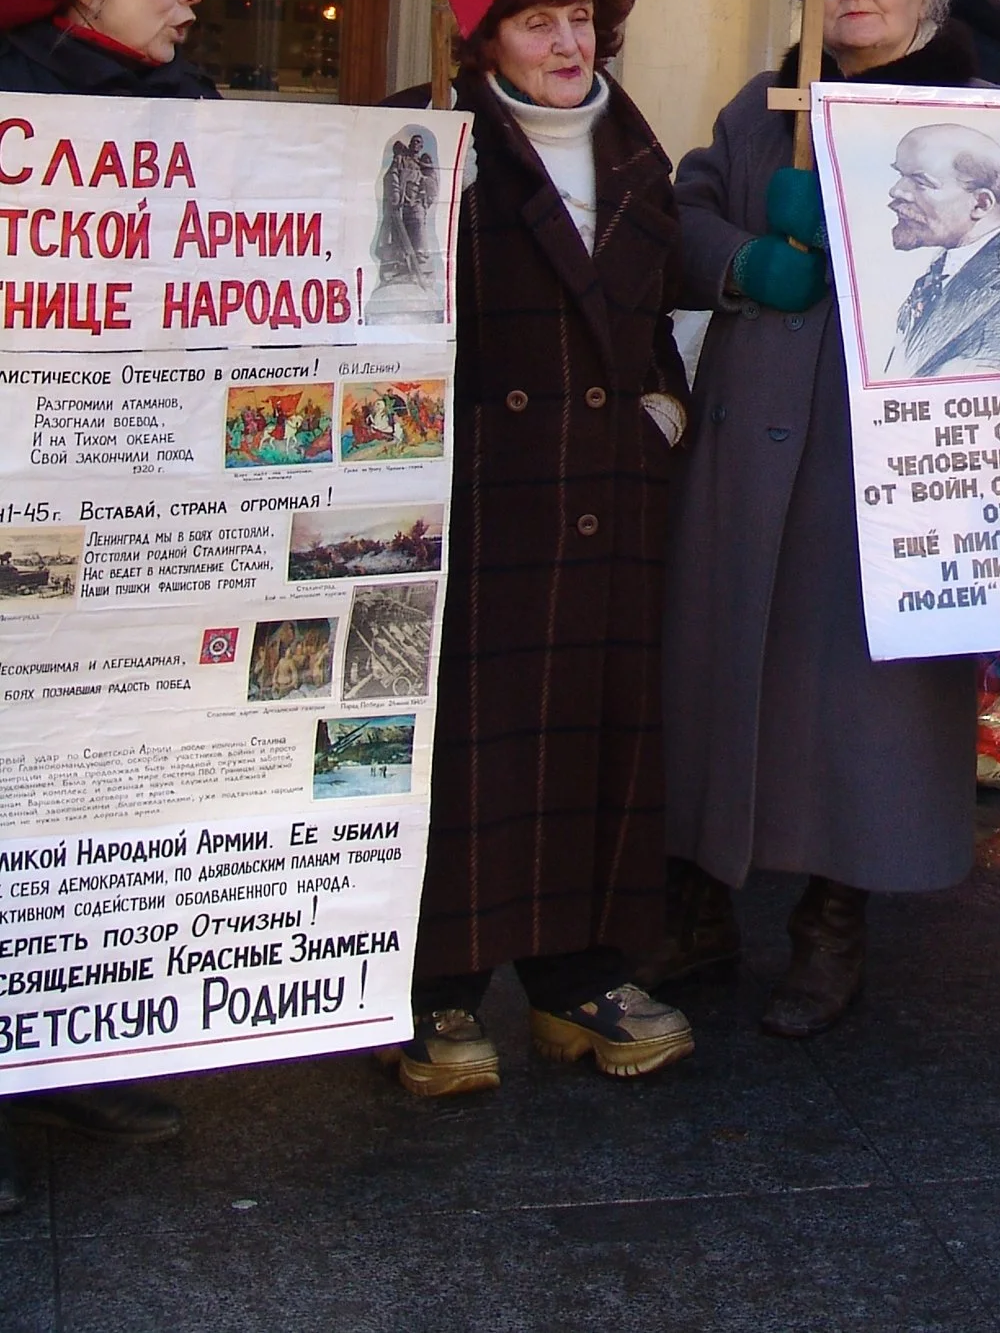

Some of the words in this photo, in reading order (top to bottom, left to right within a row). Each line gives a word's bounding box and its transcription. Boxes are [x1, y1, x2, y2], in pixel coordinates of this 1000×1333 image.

[0, 118, 196, 188] СЛАВА
[0, 197, 151, 259] ТСКОЙ
[174, 200, 332, 262] АРМИИ,
[0, 280, 132, 335] НИЦЕ
[163, 267, 364, 330] НАРОДОВ!
[122, 365, 205, 384] ОТЕЧЕСТВО
[214, 369, 222, 380] В
[231, 358, 319, 380] ОПАСНОСТИ!
[37, 397, 113, 410] РАЗГРОМИЛИ
[122, 398, 183, 410] АТАМАНОВ,
[34, 415, 105, 428] РАЗОГНАЛИ
[114, 416, 165, 428] ВОЕВОД,
[33, 432, 42, 446] И
[50, 436, 66, 446] НА
[74, 432, 117, 446] ТИХОМ
[127, 432, 175, 445] ОКЕАНЕ
[935, 424, 979, 446] НЕТ
[30, 449, 67, 464] СВОЙ
[75, 450, 149, 463] ЗАКОНЧИЛИ
[157, 449, 194, 462] ПОХОД
[80, 501, 160, 521] ВСТАВАЙ,
[170, 501, 227, 516] СТРАНА
[240, 487, 332, 512] ОГРОМНАЯ!
[864, 484, 897, 505] ОТ
[911, 477, 984, 503] ВОЙН,
[86, 532, 150, 547] ЛЕНИНГРАД
[155, 533, 172, 543] МЫ
[177, 532, 184, 542] В
[189, 530, 212, 542] БОЯХ
[893, 529, 940, 558] ЕЩЁ
[84, 550, 140, 565] ОТСТОЯЛИ
[147, 546, 187, 560] РОДНОЙ
[83, 567, 104, 581] НАС
[147, 565, 153, 576] В
[158, 562, 224, 575] НАСТУПЛЕНИЕ
[941, 561, 959, 581] И
[81, 584, 109, 598] НАШИ
[116, 584, 150, 595] ПУШКИ
[158, 579, 211, 592] ФАШИСТОВ
[217, 577, 256, 590] ГРОМЯТ
[0, 661, 79, 676] ЕСОКРУШИМАЯ
[89, 660, 97, 670] И
[4, 689, 35, 701] БОЯХ
[43, 684, 101, 699] ПОЗНАВШАЯ
[108, 681, 150, 694] РАДОСТЬ
[156, 679, 191, 691] ПОБЕД
[77, 830, 187, 865] НАРОДНОЙ
[332, 821, 399, 842] УБИЛИ
[11, 880, 50, 898] СЕБЯ
[58, 868, 168, 896] ДЕМОКРАТАМИ,
[174, 867, 192, 882] ПО
[198, 856, 285, 882] ДЬЯВОЛЬСКИМ
[291, 852, 340, 869] ПЛАНАМ
[348, 847, 402, 864] ТВОРЦОВ
[74, 893, 166, 918] СОДЕЙСТВИИ
[175, 883, 288, 908] ОБОЛВАНЕННОГО
[297, 875, 356, 894] НАРОДА.
[103, 923, 178, 948] ПОЗОР
[191, 894, 319, 937] ОТЧИЗНЫ!
[167, 944, 283, 978] КРАСНЫЕ
[202, 959, 368, 1029] РОДИНУ!
